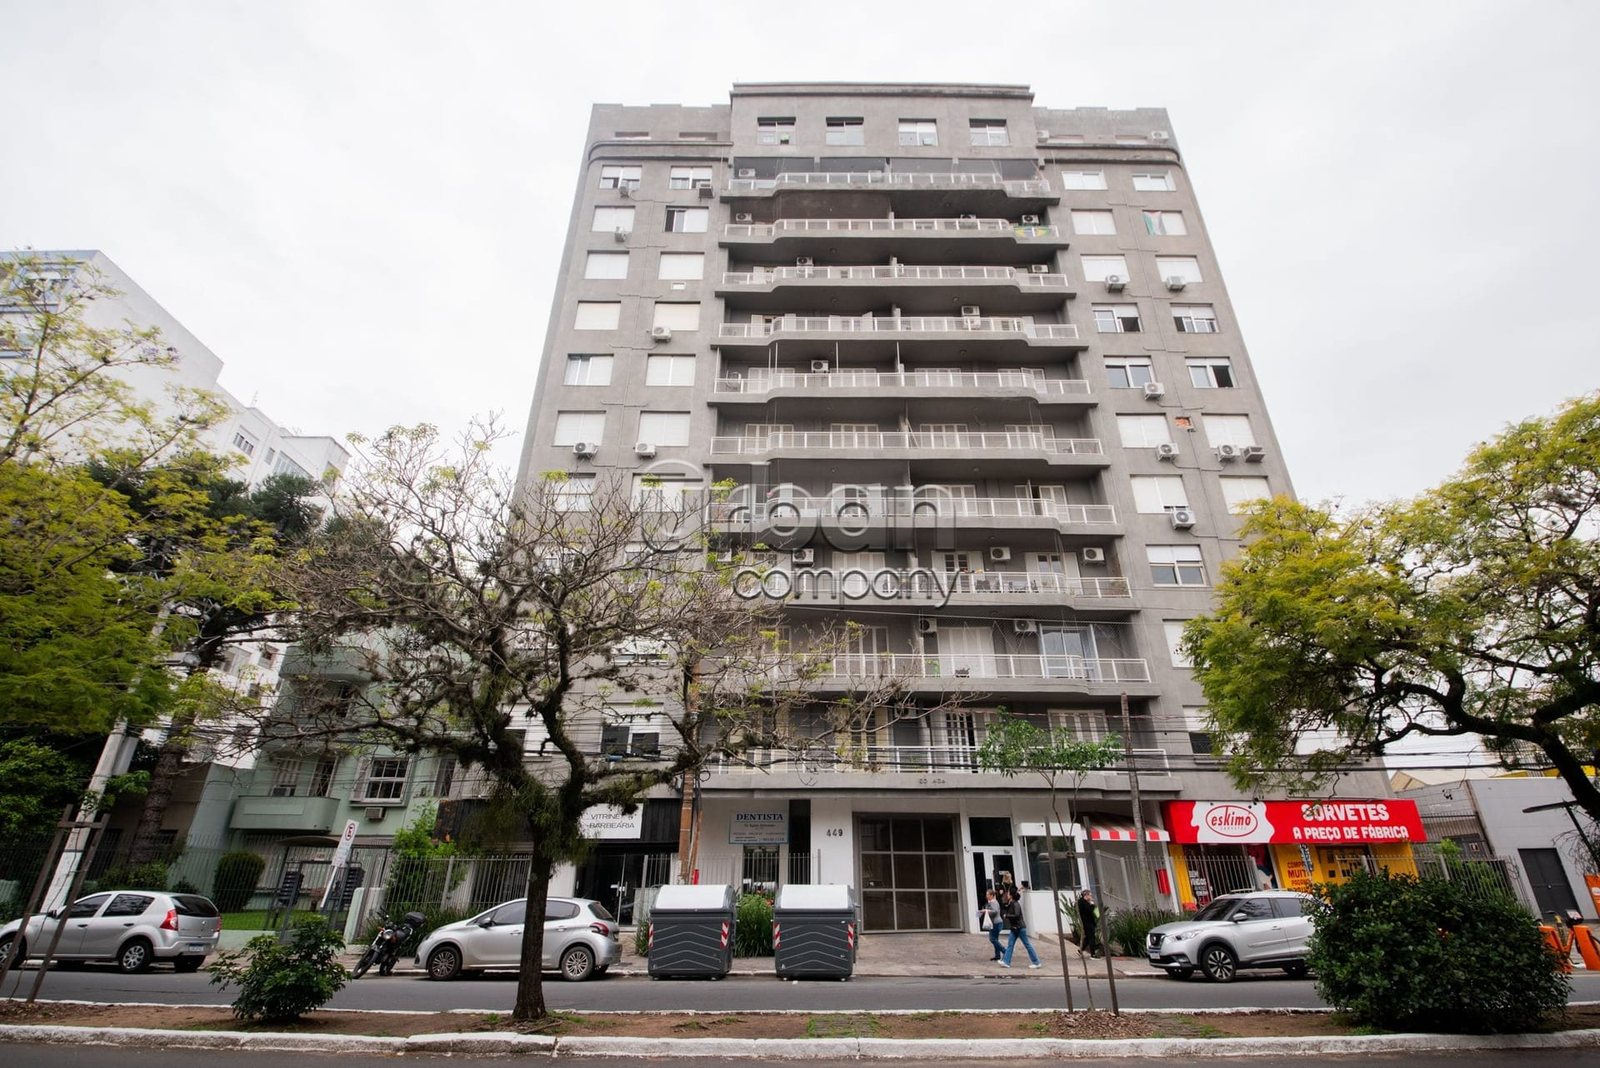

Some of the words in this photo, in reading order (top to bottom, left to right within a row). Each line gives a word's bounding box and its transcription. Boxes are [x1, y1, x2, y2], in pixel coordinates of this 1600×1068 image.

[1301, 803, 1390, 821] SORVETES
[736, 813, 783, 821] DENTISTA
[826, 828, 843, 837] 449
[1292, 826, 1302, 839] A
[1303, 826, 1341, 841] PREÇO
[1342, 826, 1360, 839] DE
[1361, 824, 1409, 839] FÁBRICA
[1287, 869, 1308, 878] MUIT
